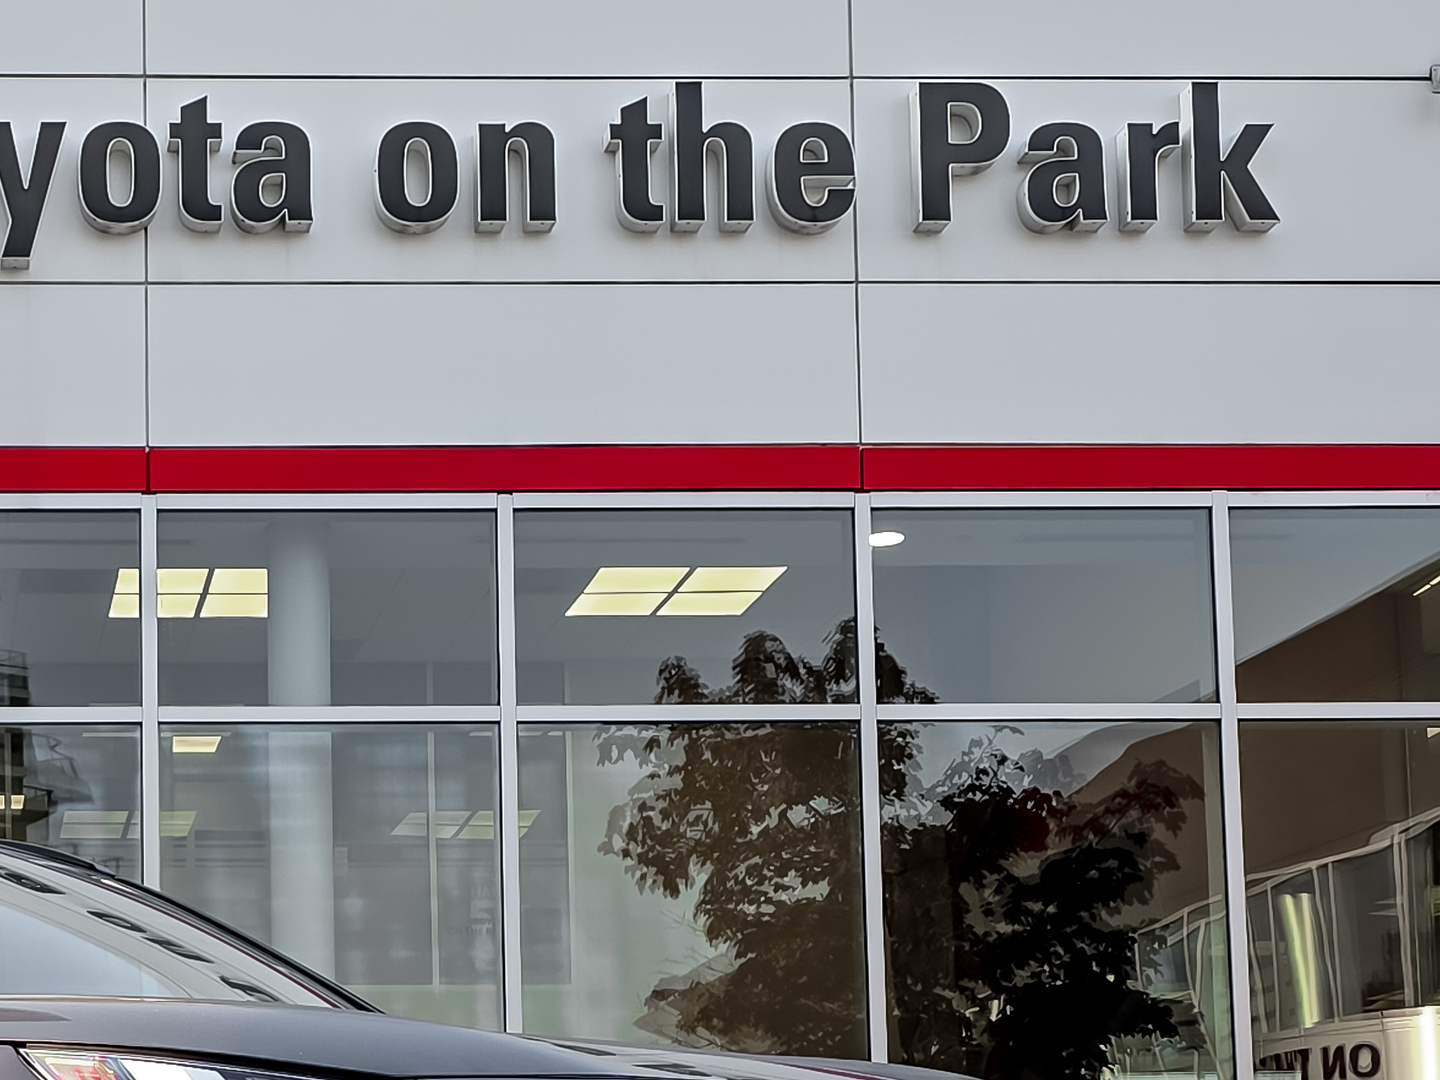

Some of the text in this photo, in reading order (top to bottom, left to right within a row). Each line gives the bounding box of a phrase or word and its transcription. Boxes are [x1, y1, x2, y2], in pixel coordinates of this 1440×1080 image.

[375, 120, 556, 234] on
[602, 80, 857, 234] the
[908, 81, 1281, 234] Park
